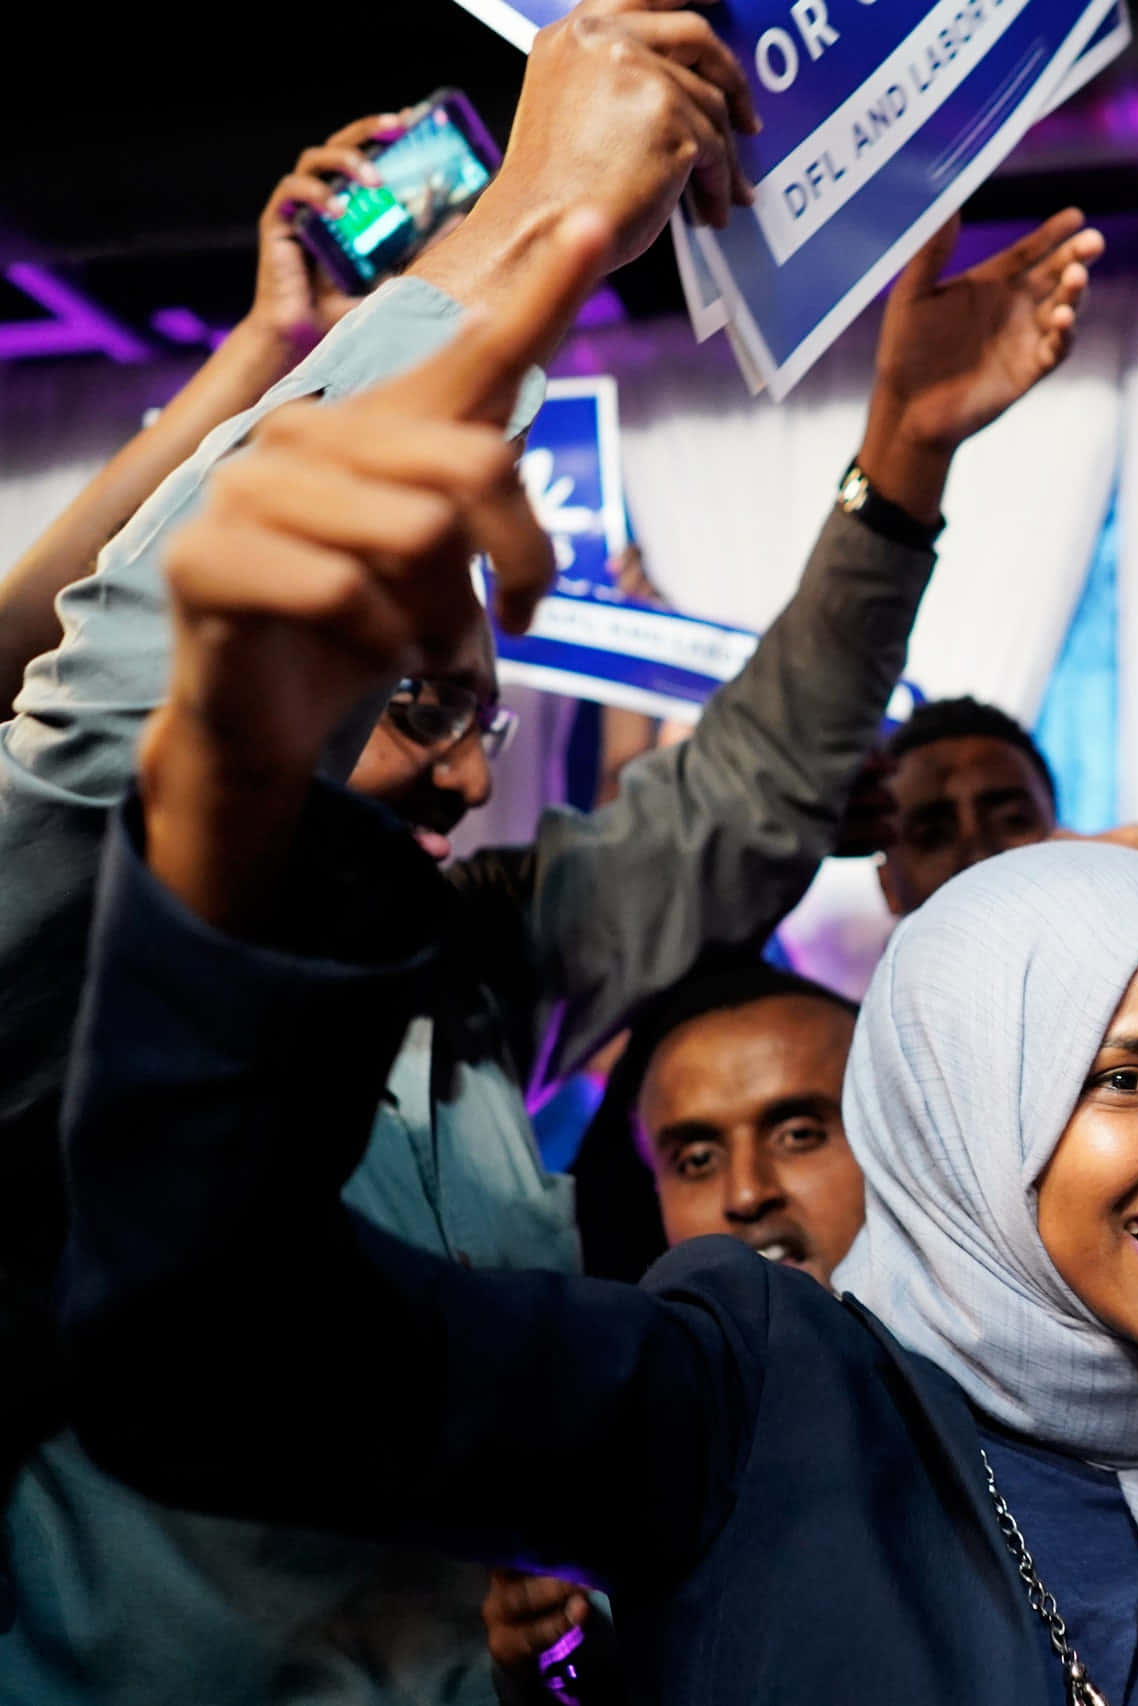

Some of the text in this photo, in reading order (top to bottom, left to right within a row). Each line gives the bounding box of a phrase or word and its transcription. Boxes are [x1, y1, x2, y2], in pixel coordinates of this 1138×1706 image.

[755, 0, 840, 93] OR
[783, 149, 847, 220] DFL
[851, 82, 909, 158] AND
